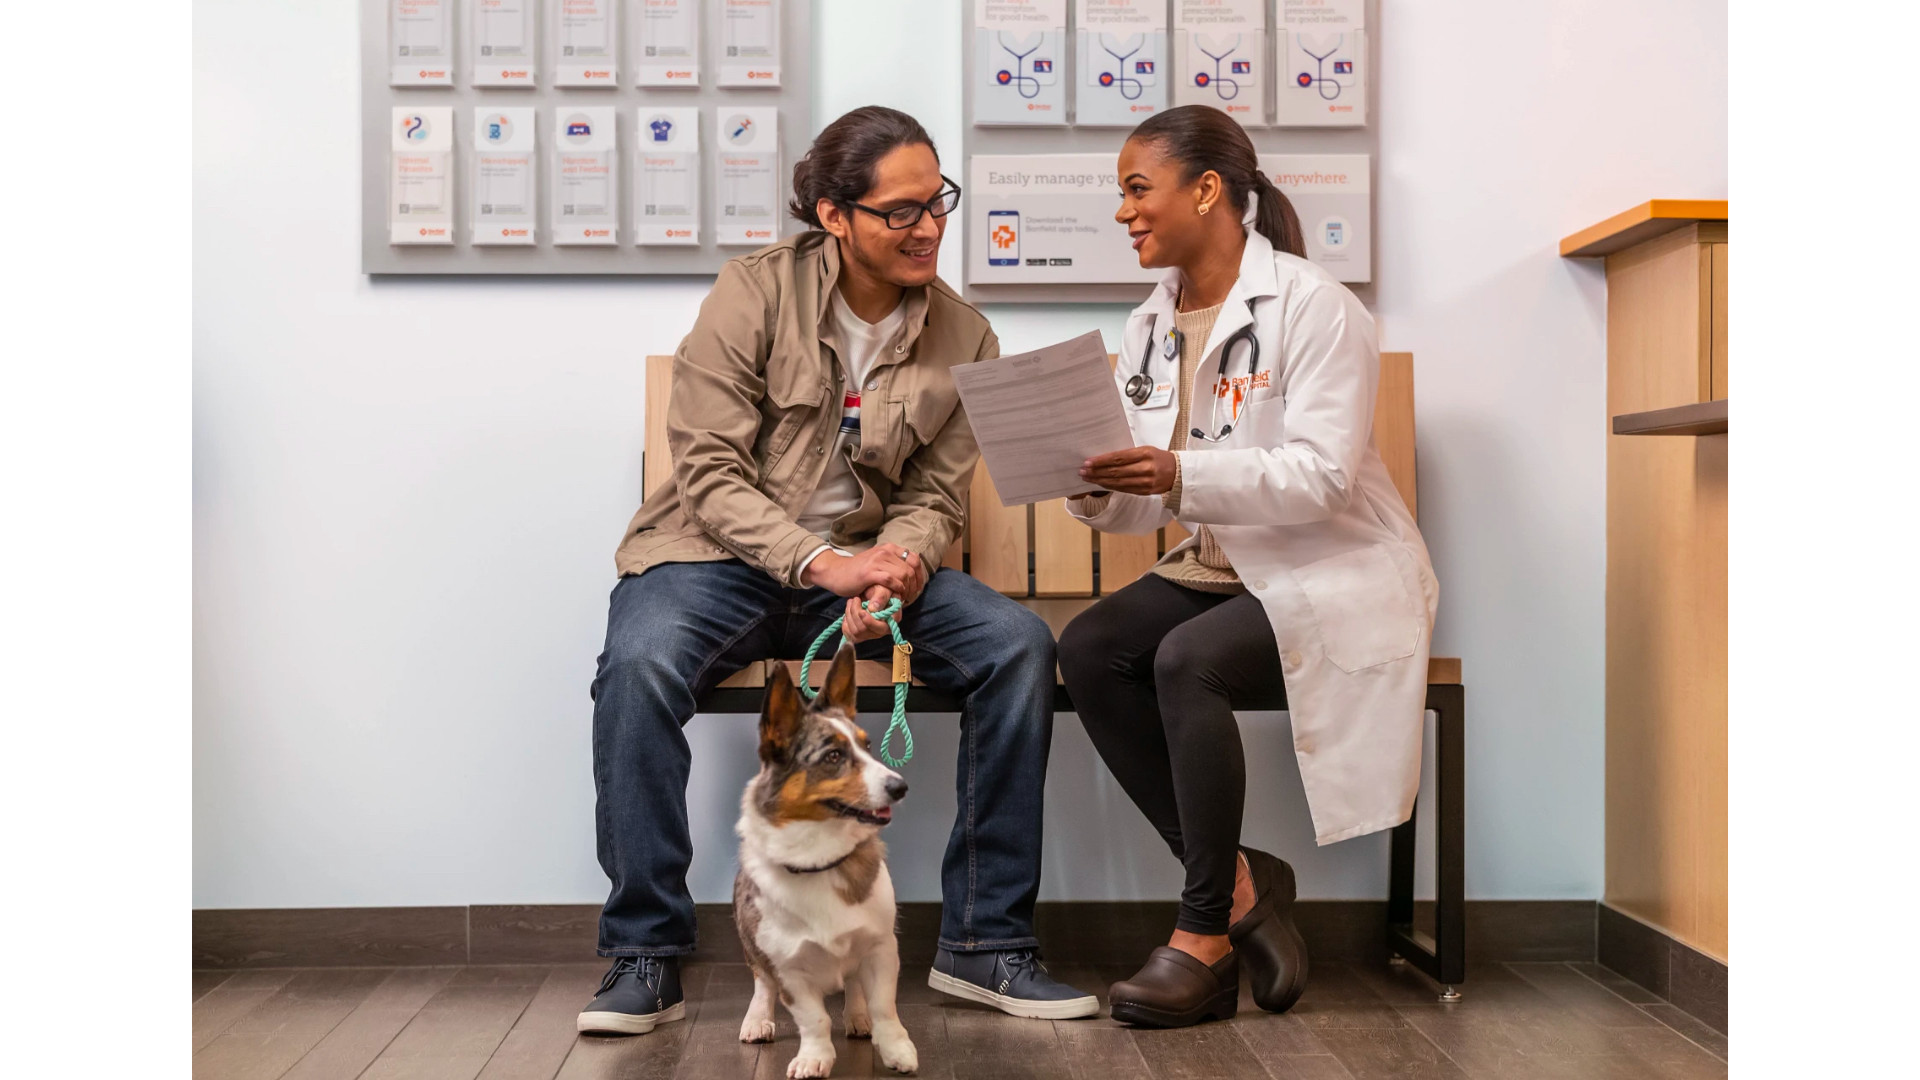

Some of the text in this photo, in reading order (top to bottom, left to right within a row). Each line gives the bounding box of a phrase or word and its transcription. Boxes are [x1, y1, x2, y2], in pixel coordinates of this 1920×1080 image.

[985, 5, 1037, 13] prescription
[1086, 8, 1137, 16] prescription
[1182, 8, 1233, 16] prescription
[1284, 8, 1336, 16] prescription
[999, 14, 1021, 23] good
[1023, 14, 1050, 22] health
[1101, 16, 1121, 25] good
[1197, 16, 1217, 25] good
[1299, 16, 1320, 25] good
[988, 172, 1030, 188] Easily
[1034, 174, 1094, 188] manage
[1097, 174, 1118, 188] yo
[1232, 371, 1269, 388] Baneld
